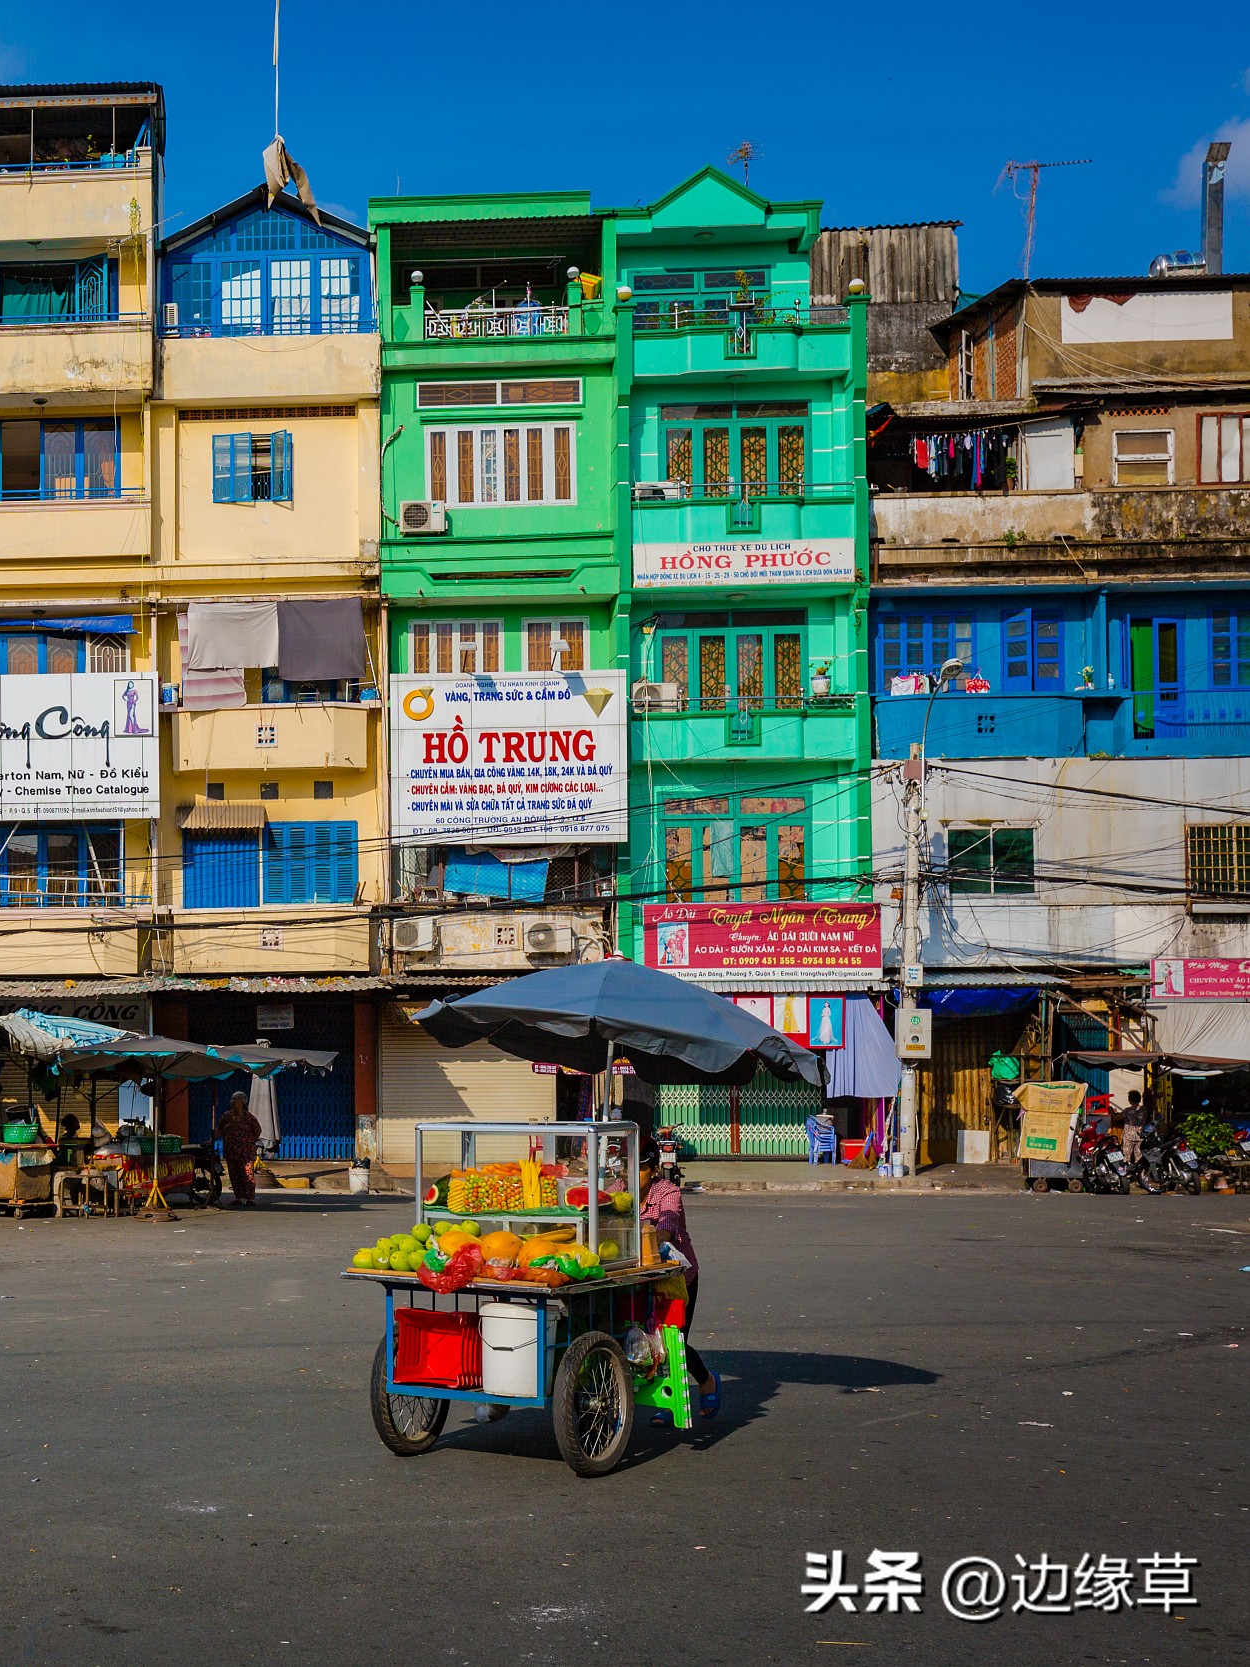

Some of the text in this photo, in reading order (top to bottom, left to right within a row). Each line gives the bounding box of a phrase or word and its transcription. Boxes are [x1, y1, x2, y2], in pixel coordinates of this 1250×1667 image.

[714, 543, 737, 552] THUÊ
[770, 543, 790, 551] LỊCH
[660, 547, 831, 570] HỒNG PHƯỚC
[445, 690, 471, 703] VÀNG,
[474, 691, 503, 702] TRANG
[506, 689, 524, 700] SỨC
[526, 691, 533, 700] &
[558, 686, 570, 700] ĐỒ
[35, 706, 110, 768] Công
[422, 714, 596, 764] HỒ TRUNG
[36, 770, 64, 781] Nam,
[68, 770, 85, 780] Nữ
[100, 768, 117, 778] Đồ
[122, 766, 149, 778] Kiểu
[410, 763, 613, 780] CHUYÊN MUA BÁN, GIA CÔNG VÀNG 14K, 18K, 24K VÀ ĐÁ QUÝ
[14, 786, 62, 796] Chemise
[65, 786, 92, 795] Theo
[96, 785, 150, 796] Catalogue
[412, 782, 438, 795] CHUYÊN
[459, 782, 477, 794] VÀNG
[478, 784, 494, 796] BẠC,
[496, 782, 506, 794] ĐÁ
[508, 782, 523, 795] QUÝ,
[526, 783, 538, 793] KIM
[540, 782, 563, 793] CƯƠNG
[564, 781, 578, 792] CÁC
[412, 796, 592, 812] CHUYÊN MÀI VÀ SỬA CHỮA TẤT CẢ TRANG SỨC ĐÁ QUÝ
[446, 816, 470, 824] CÔNG
[759, 908, 805, 930] Ngân
[813, 906, 877, 930] (Trang)
[767, 930, 778, 941] ÁO
[782, 930, 796, 941] DÀI
[821, 932, 840, 941] NAM
[843, 930, 854, 941] NỮ
[694, 944, 707, 954] ÁO
[709, 944, 723, 954] DÀI
[756, 944, 774, 953] XÁM
[782, 944, 795, 953] ÁO
[796, 944, 811, 953] DÀI
[848, 944, 863, 953] KẾT
[865, 944, 878, 953] ĐÁ
[1208, 962, 1230, 972] May
[1190, 976, 1218, 984] CHUYÊN
[74, 1002, 139, 1020] CÔNG
